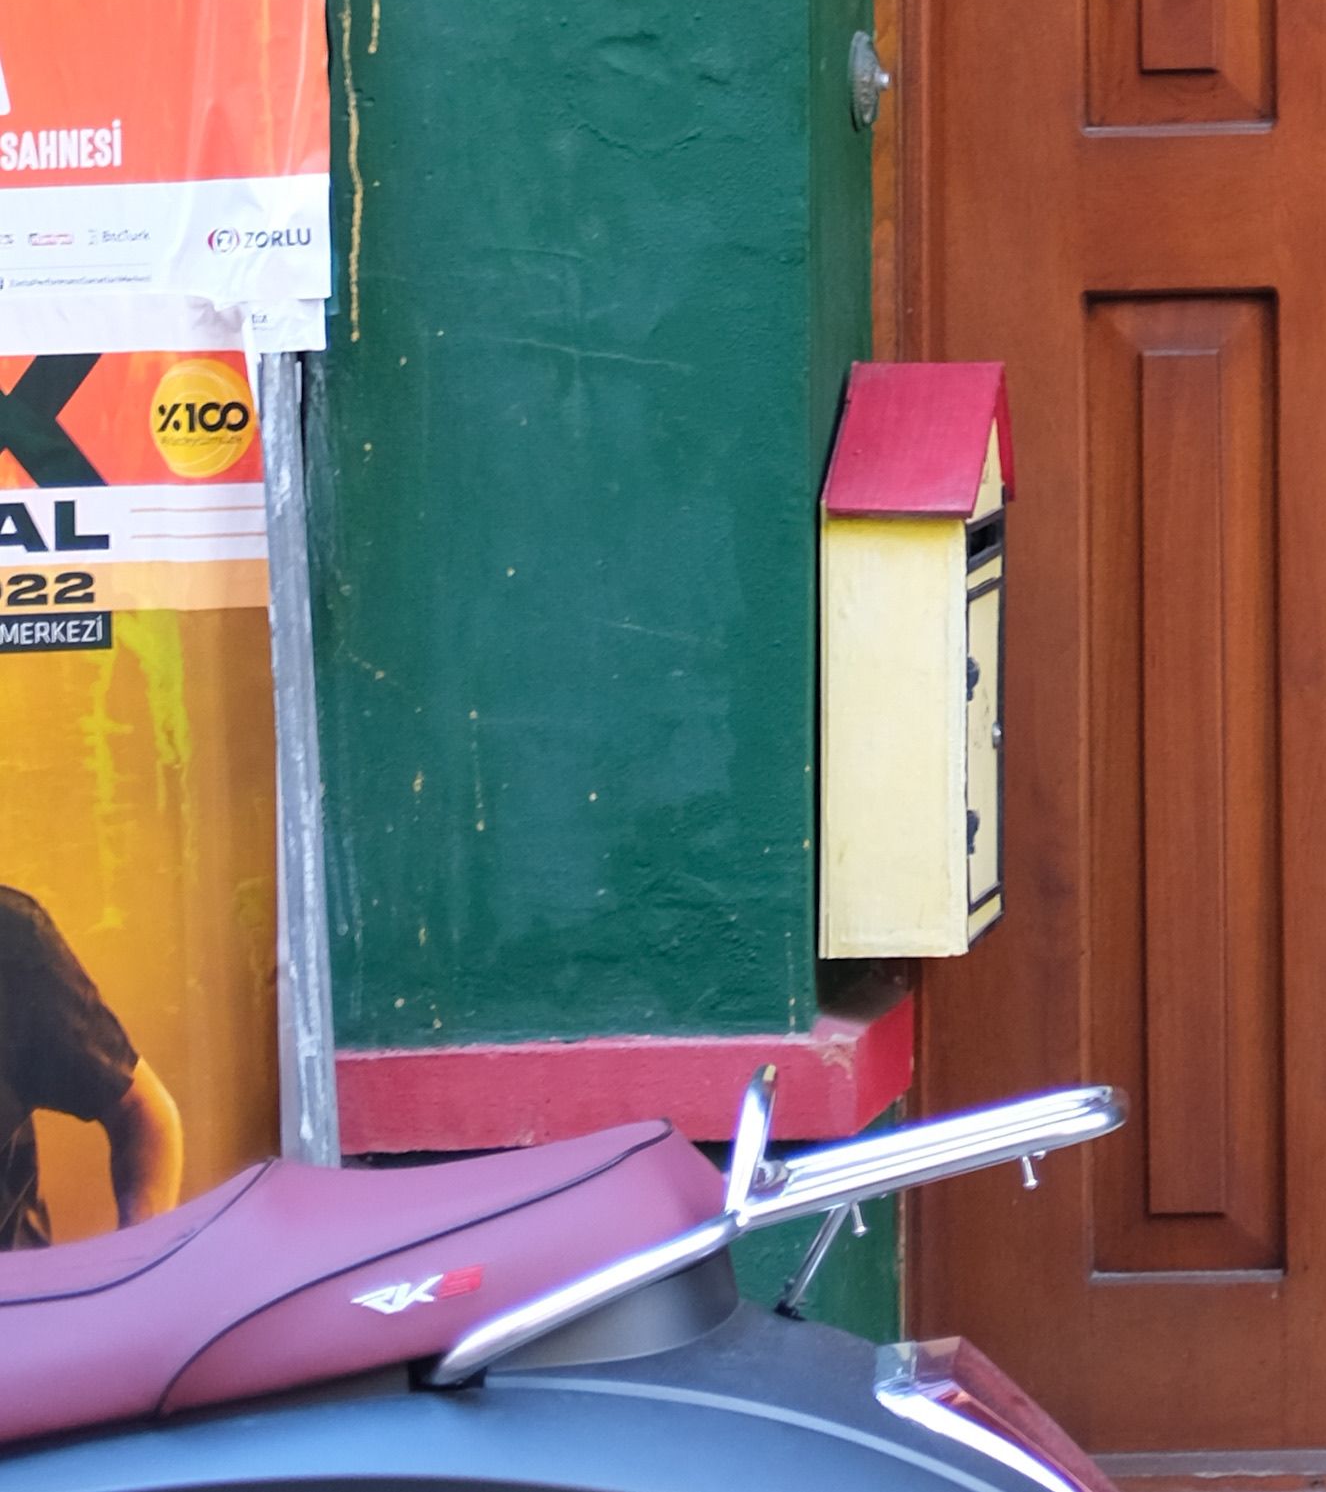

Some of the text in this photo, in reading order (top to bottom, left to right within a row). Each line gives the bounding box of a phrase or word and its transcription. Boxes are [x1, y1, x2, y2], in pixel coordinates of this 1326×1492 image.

[0, 118, 122, 172] SAHNESİ
[243, 228, 311, 248] ZORLU
[156, 400, 250, 432] %100
[0, 571, 96, 607] 22
[0, 613, 103, 646] MERKEZİ
